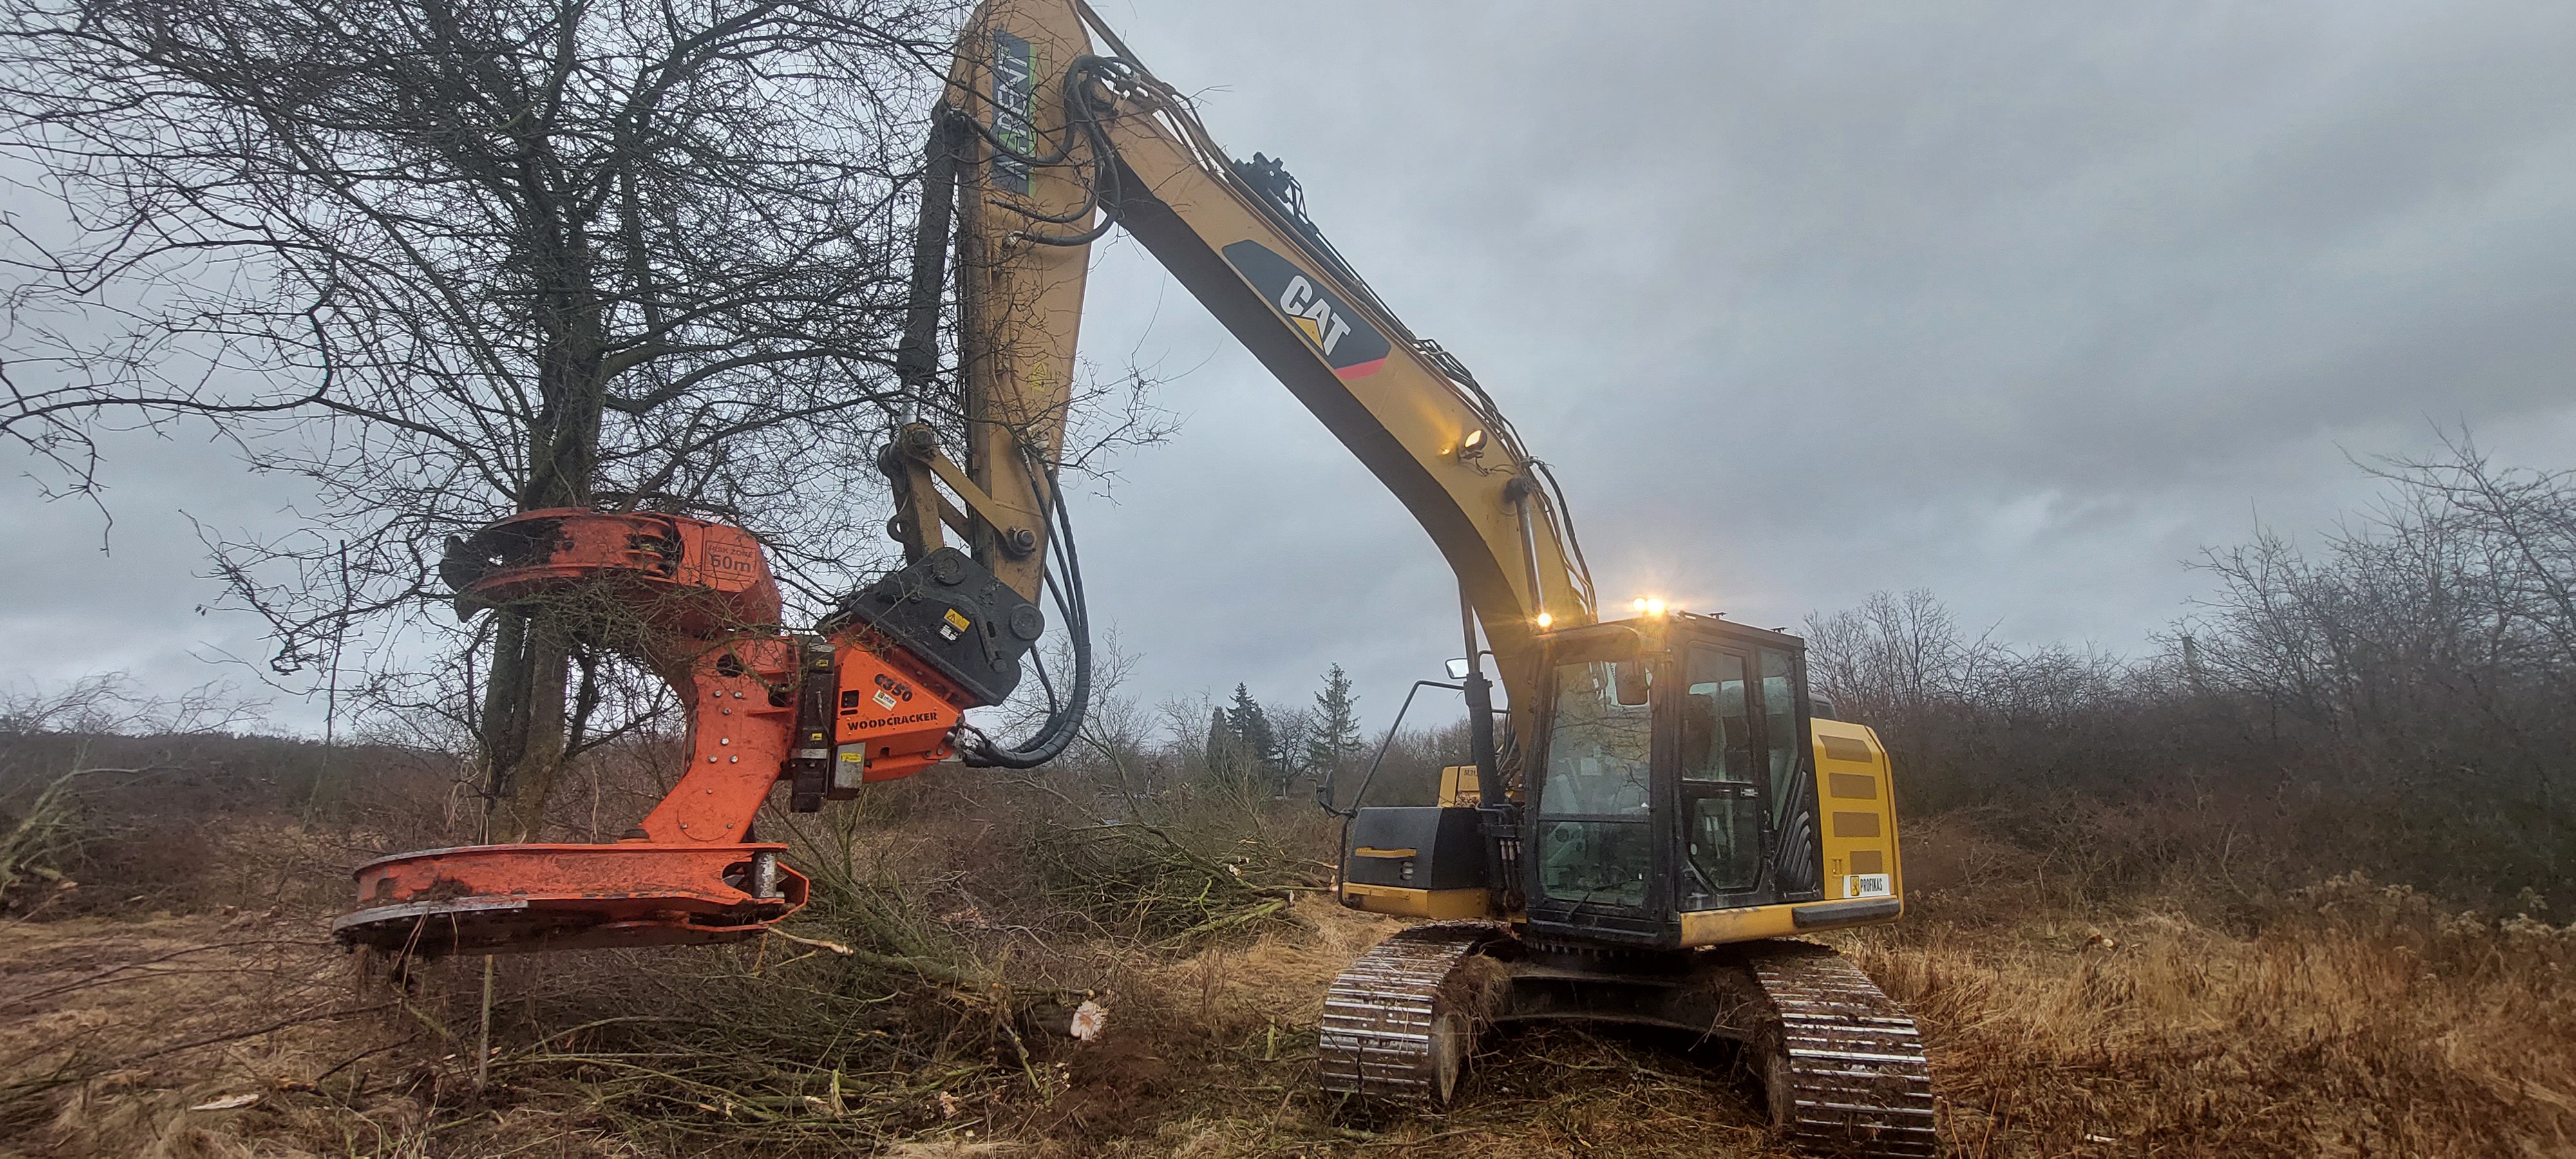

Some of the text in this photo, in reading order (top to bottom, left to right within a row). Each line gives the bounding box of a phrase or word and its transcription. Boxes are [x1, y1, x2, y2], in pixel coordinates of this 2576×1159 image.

[1280, 275, 1352, 356] CAT
[708, 545, 753, 558] RISK ZONE
[710, 554, 751, 572] 50m
[875, 674, 913, 702] C350
[848, 711, 938, 731] WOODCRACKER
